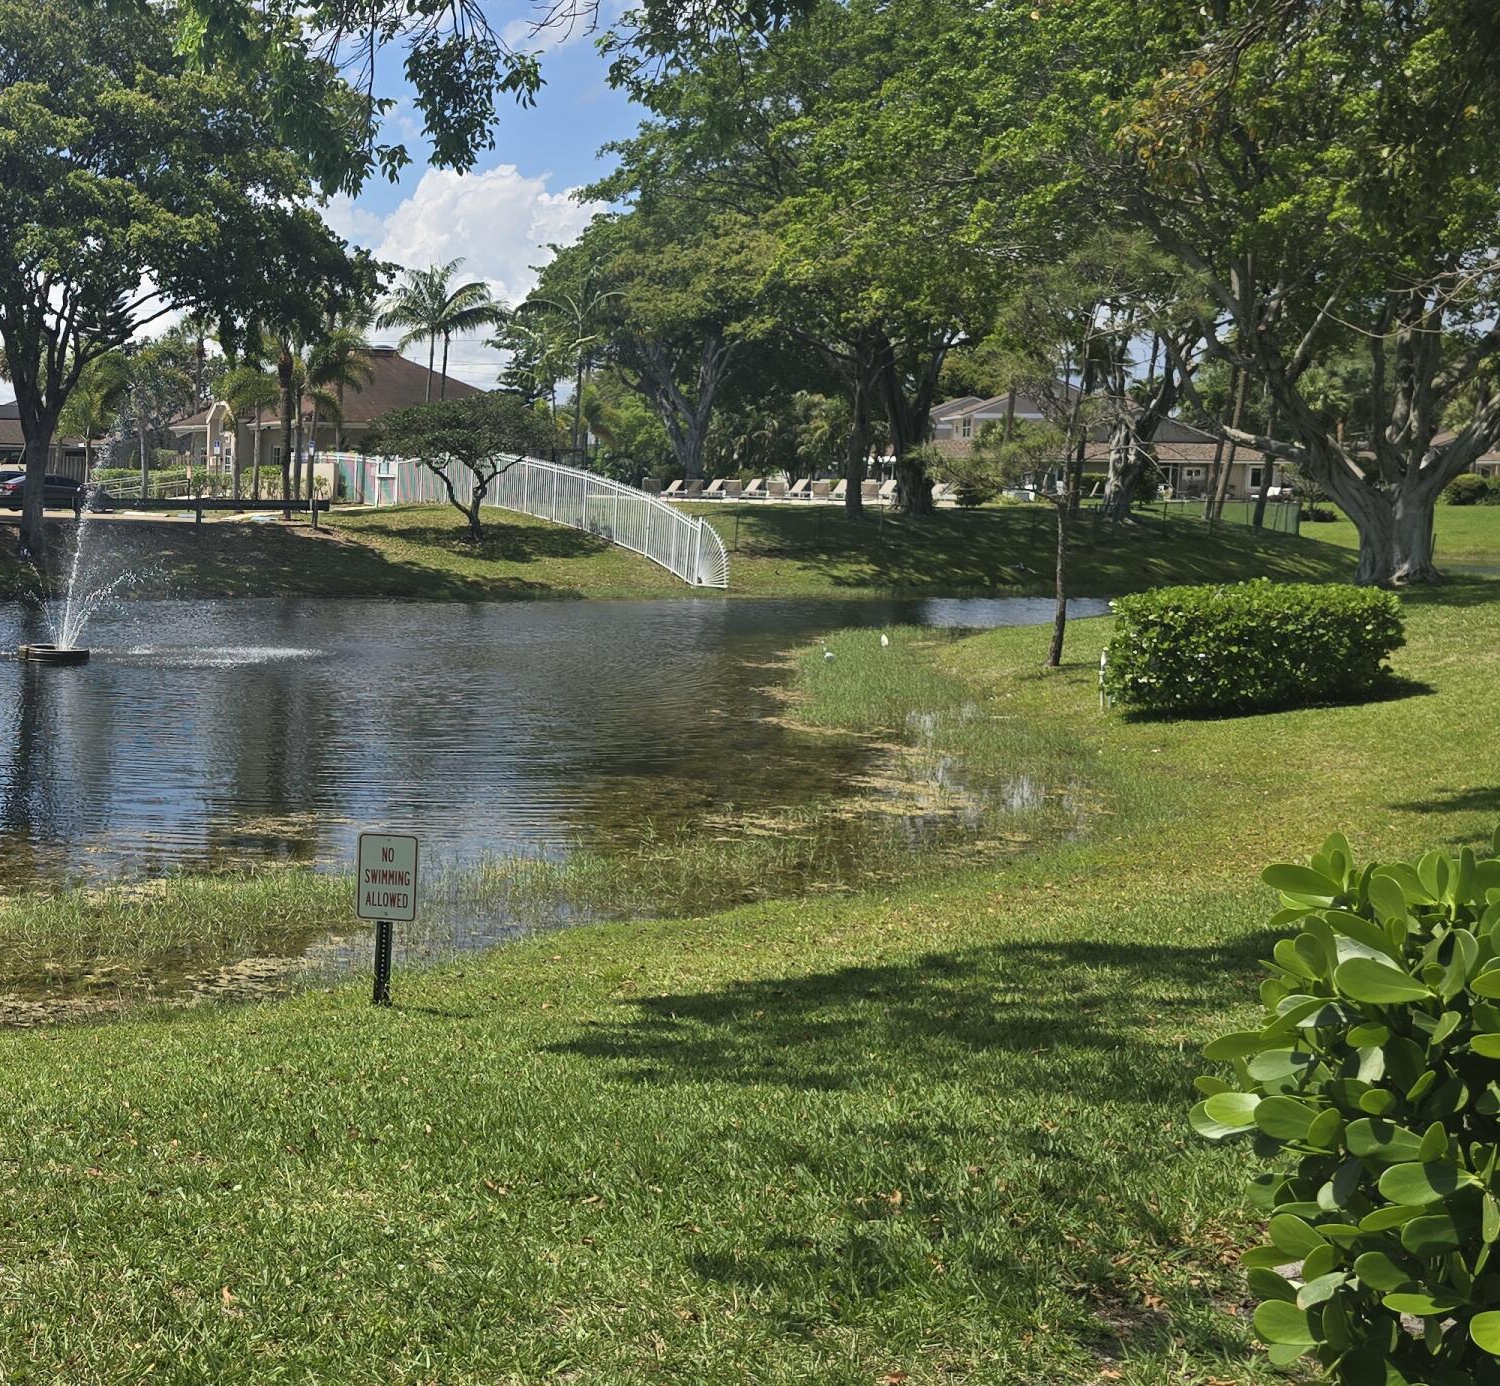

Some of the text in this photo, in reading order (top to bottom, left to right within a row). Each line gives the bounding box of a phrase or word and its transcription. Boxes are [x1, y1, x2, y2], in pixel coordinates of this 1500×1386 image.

[381, 847, 394, 862] NO
[364, 868, 410, 886] SWIMMING
[365, 891, 408, 908] ALLOWED
